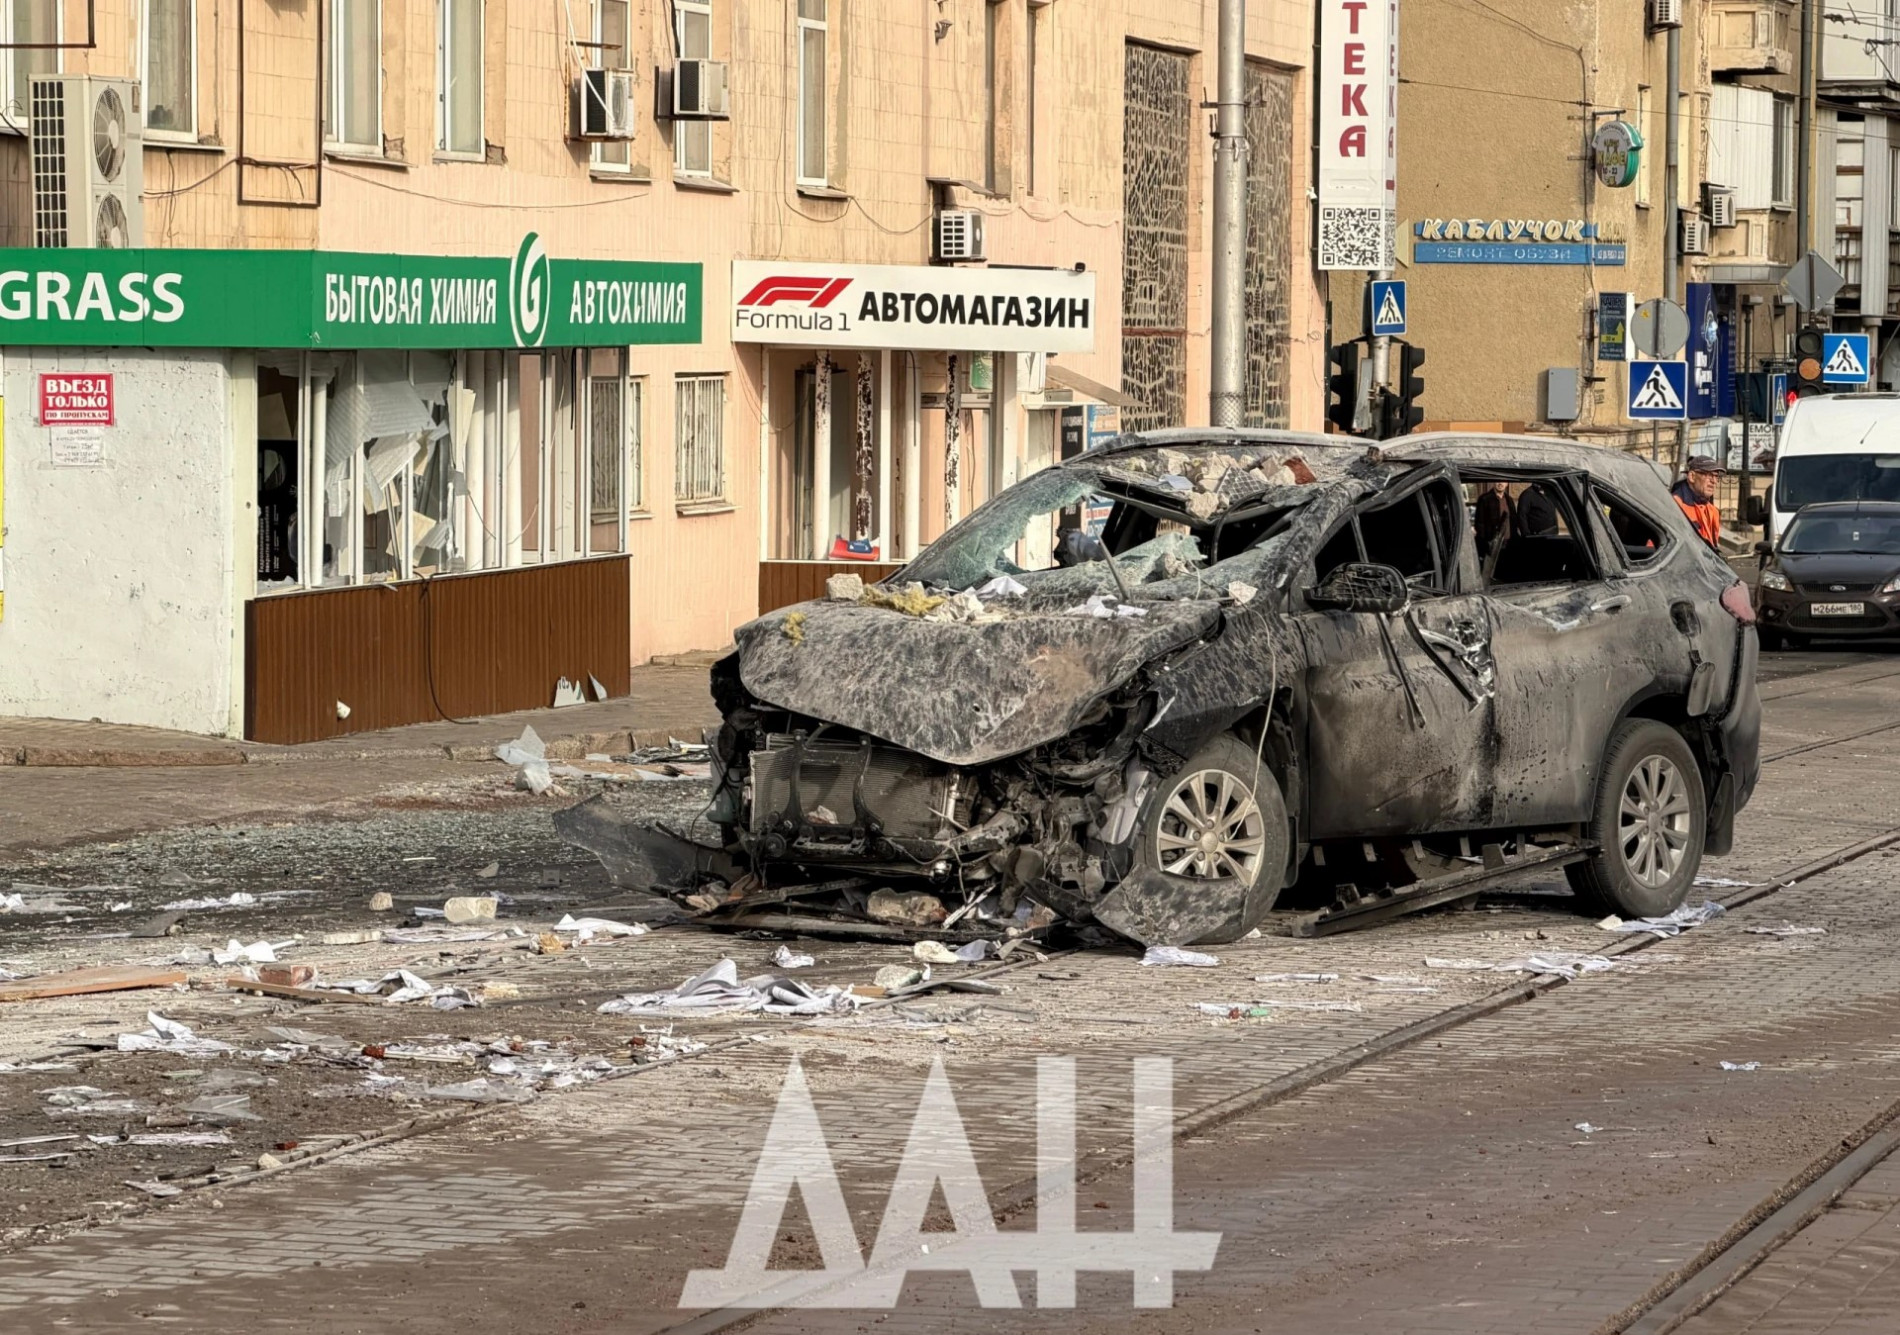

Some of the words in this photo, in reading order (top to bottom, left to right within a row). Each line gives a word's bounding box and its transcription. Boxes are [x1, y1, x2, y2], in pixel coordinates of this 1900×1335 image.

[1339, 2, 1369, 158] ТЕКА
[1422, 218, 1584, 241] КАБЛУЧОК
[1436, 247, 1506, 259] РЕМОНТ
[1514, 248, 1571, 259] ОБУВИ
[0, 271, 185, 323] GRASS
[325, 273, 422, 324] БЫТОВАЯ
[429, 277, 497, 325] ХИМИЯ
[569, 280, 686, 324] АВТОХИМИЯ
[858, 291, 1089, 329] АВТОМАГАЗИН
[736, 309, 833, 331] Formula
[838, 313, 851, 331] 1
[46, 379, 107, 395] ВЪЕЗД
[46, 396, 108, 407] ТОЛЬКО
